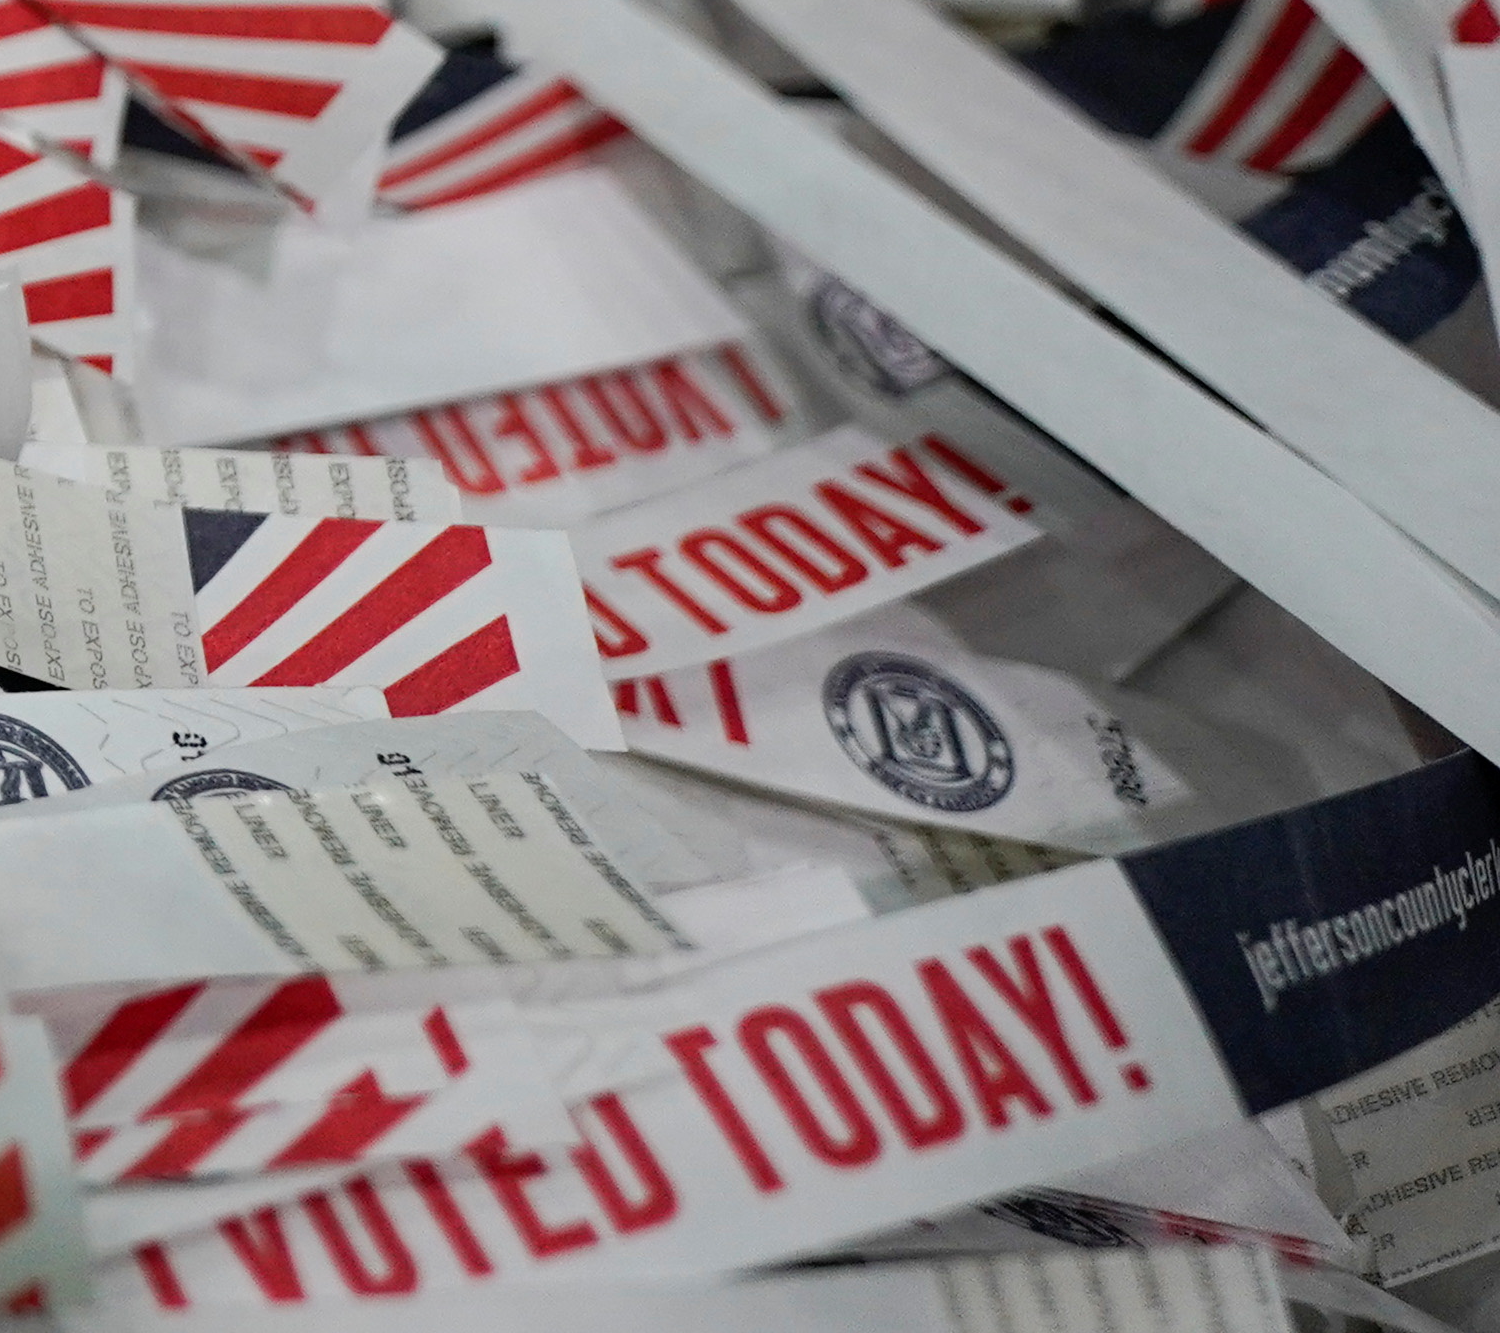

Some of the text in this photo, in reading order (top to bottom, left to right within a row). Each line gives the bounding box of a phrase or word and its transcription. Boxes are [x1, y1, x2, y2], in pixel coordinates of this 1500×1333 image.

[17, 484, 65, 682] EXPOSE ADHESIVE
[109, 508, 153, 690] XPOSE ADHESIVE
[611, 430, 1035, 636] TODAY!
[83, 621, 108, 690] EXPOS
[176, 644, 199, 689] EXP
[1236, 838, 1500, 1014] jeffersoncountycler
[665, 923, 1150, 1194] TODAY!
[1328, 1077, 1429, 1125] DHESIVE
[1431, 1049, 1500, 1087] REMO
